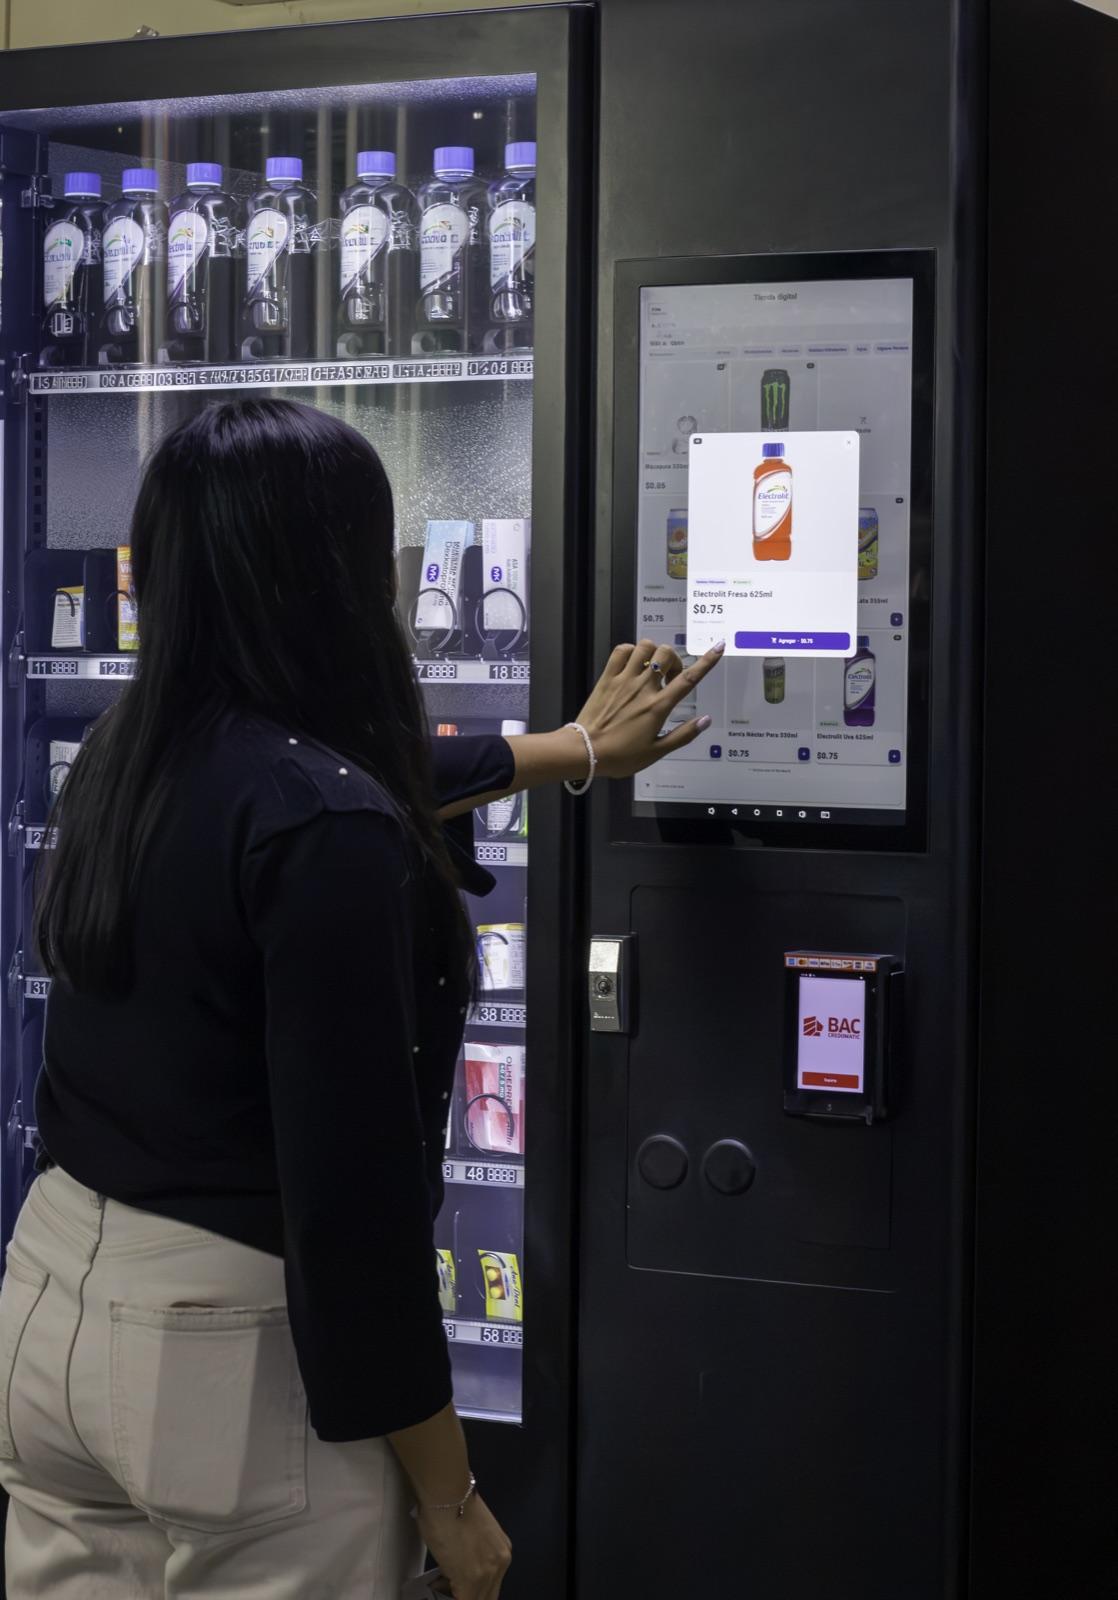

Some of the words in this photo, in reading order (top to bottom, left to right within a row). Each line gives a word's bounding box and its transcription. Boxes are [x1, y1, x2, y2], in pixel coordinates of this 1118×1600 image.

[438, 541, 453, 606] Dexketoprofno
[693, 590, 727, 598] Electrolit
[727, 590, 748, 598] Fresa
[749, 590, 773, 598] 625ml
[693, 603, 724, 615] $0.75
[642, 614, 665, 623] $0.75
[35, 662, 47, 674] 11
[102, 662, 117, 675] 12
[492, 665, 508, 680] 18
[728, 749, 750, 758] $0.75
[816, 751, 839, 760] $0.75
[33, 982, 47, 995] 31
[480, 1007, 498, 1021] 38
[828, 1016, 861, 1034] BAC
[828, 1032, 861, 1040] CREDOMATIC
[467, 1167, 485, 1181] 48
[482, 1328, 500, 1343] 58
